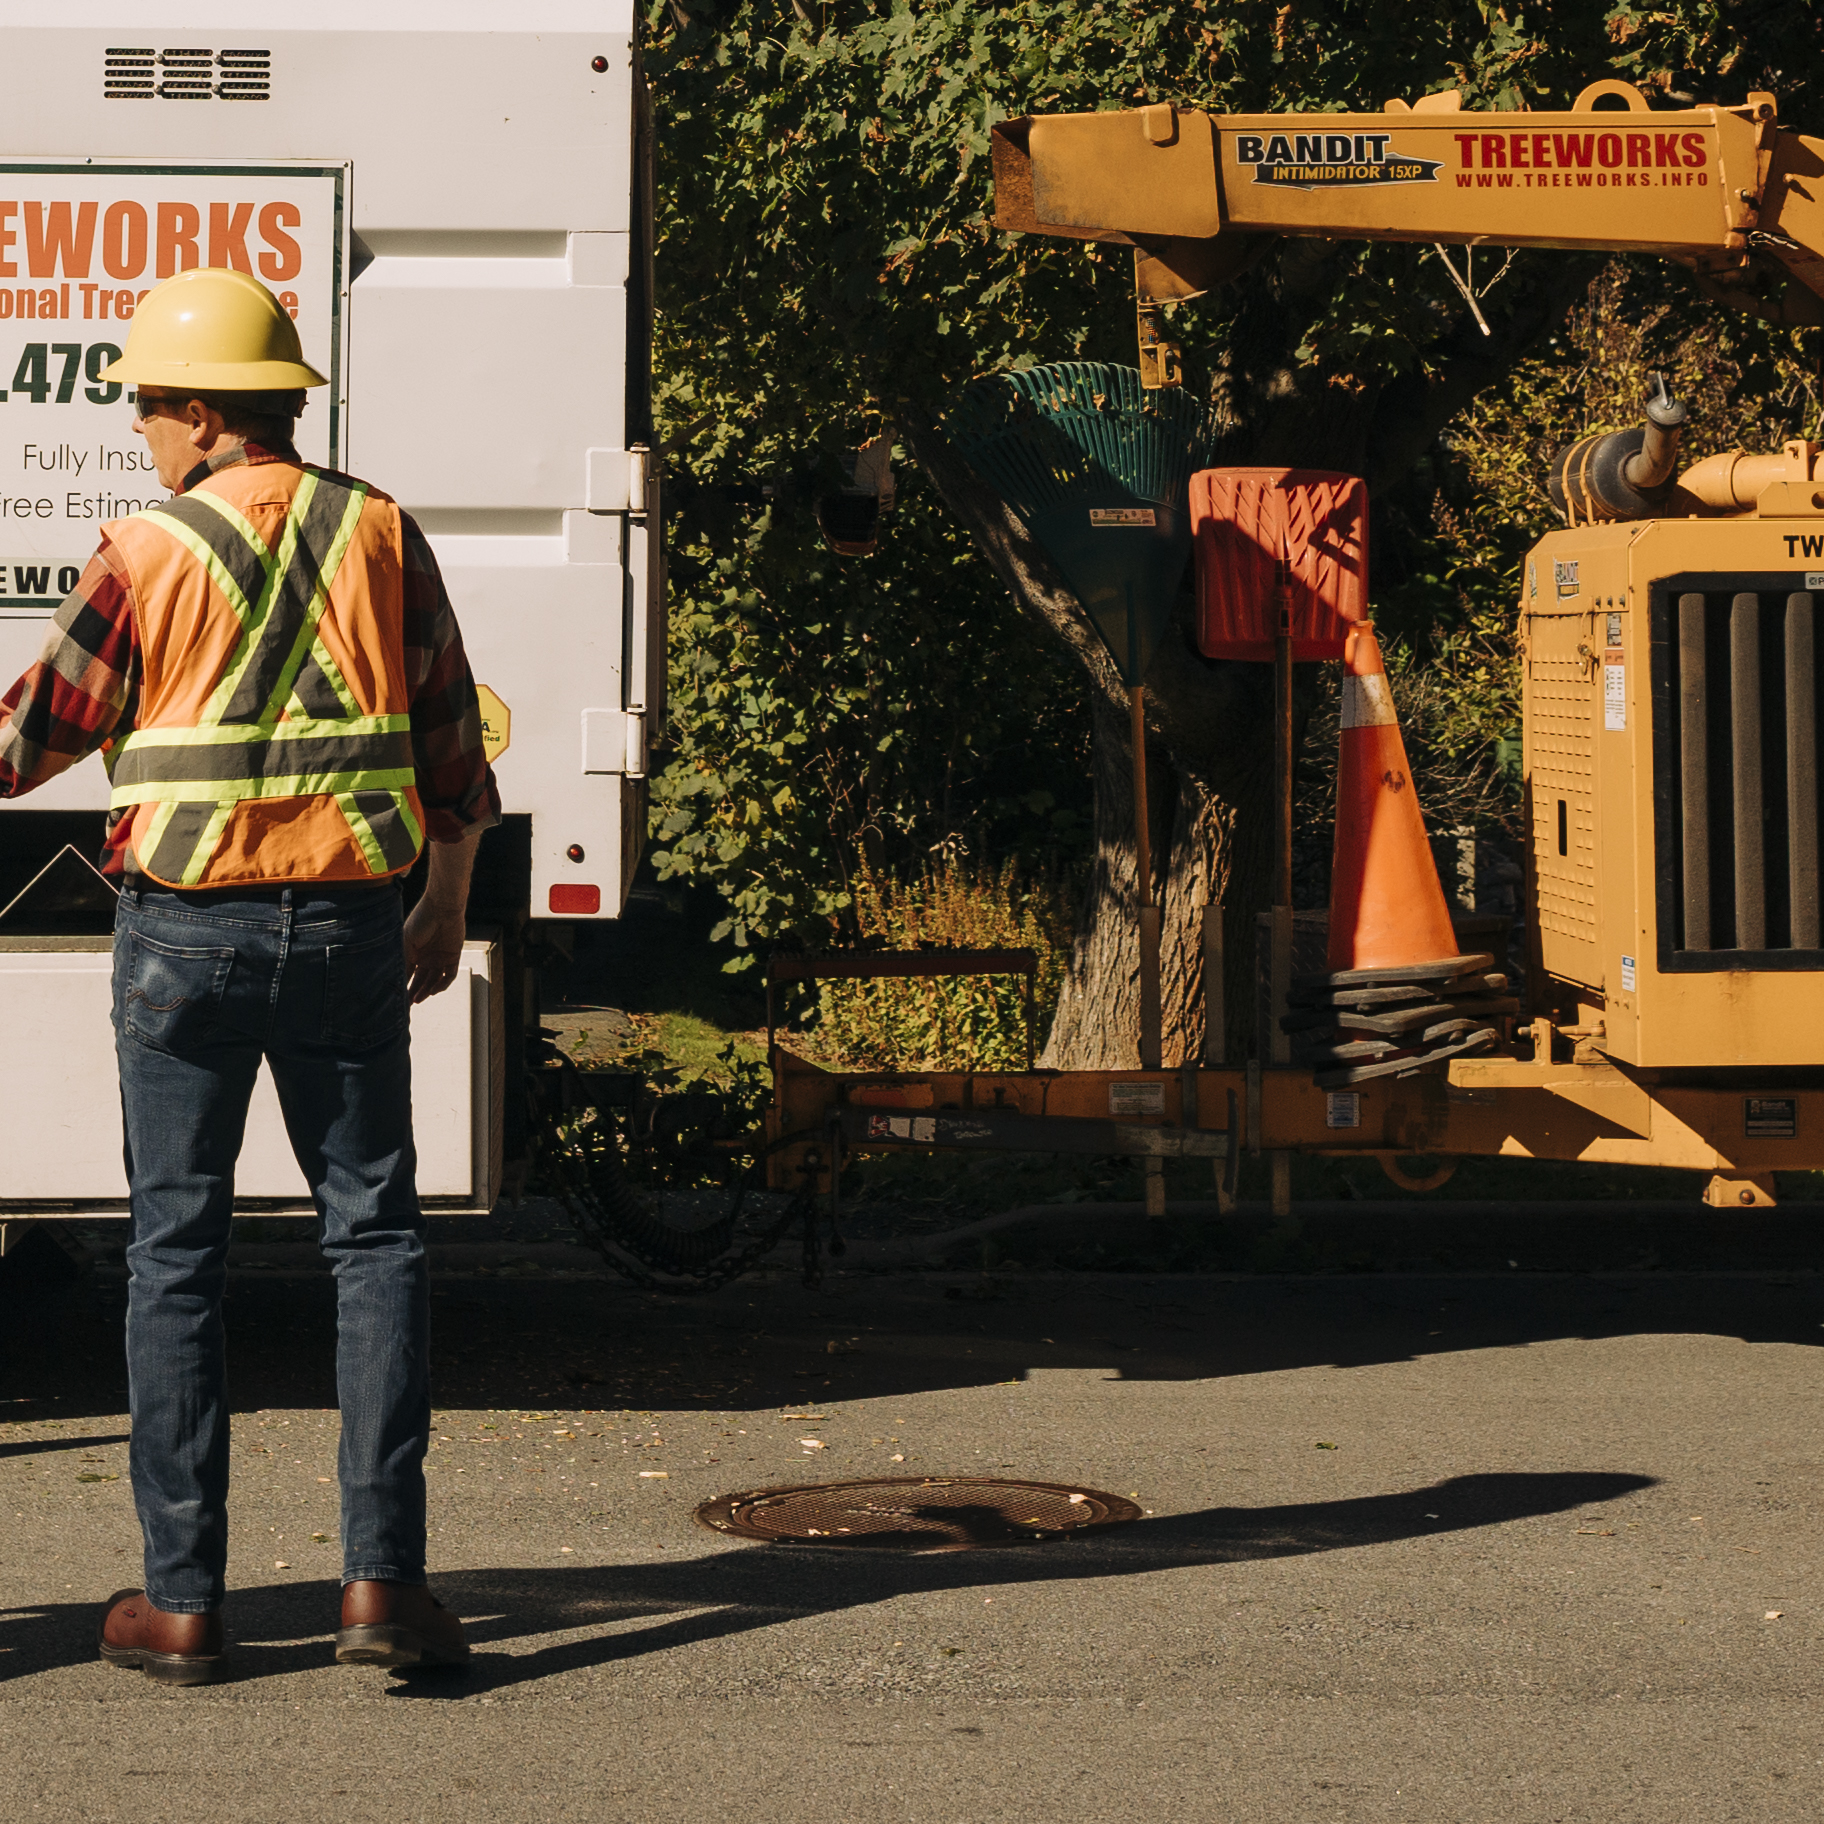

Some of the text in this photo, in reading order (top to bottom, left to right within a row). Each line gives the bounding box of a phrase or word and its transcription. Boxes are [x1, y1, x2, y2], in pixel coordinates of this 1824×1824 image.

[1236, 133, 1391, 164] BANDIT
[1454, 133, 1707, 169] TREEWORKS
[1272, 165, 1423, 180] INTIMIDATOR 15XP
[1456, 172, 1709, 188] WWW.TREEWORKS.INFO
[79, 283, 150, 320] Tre
[24, 443, 156, 476] Fully Insu
